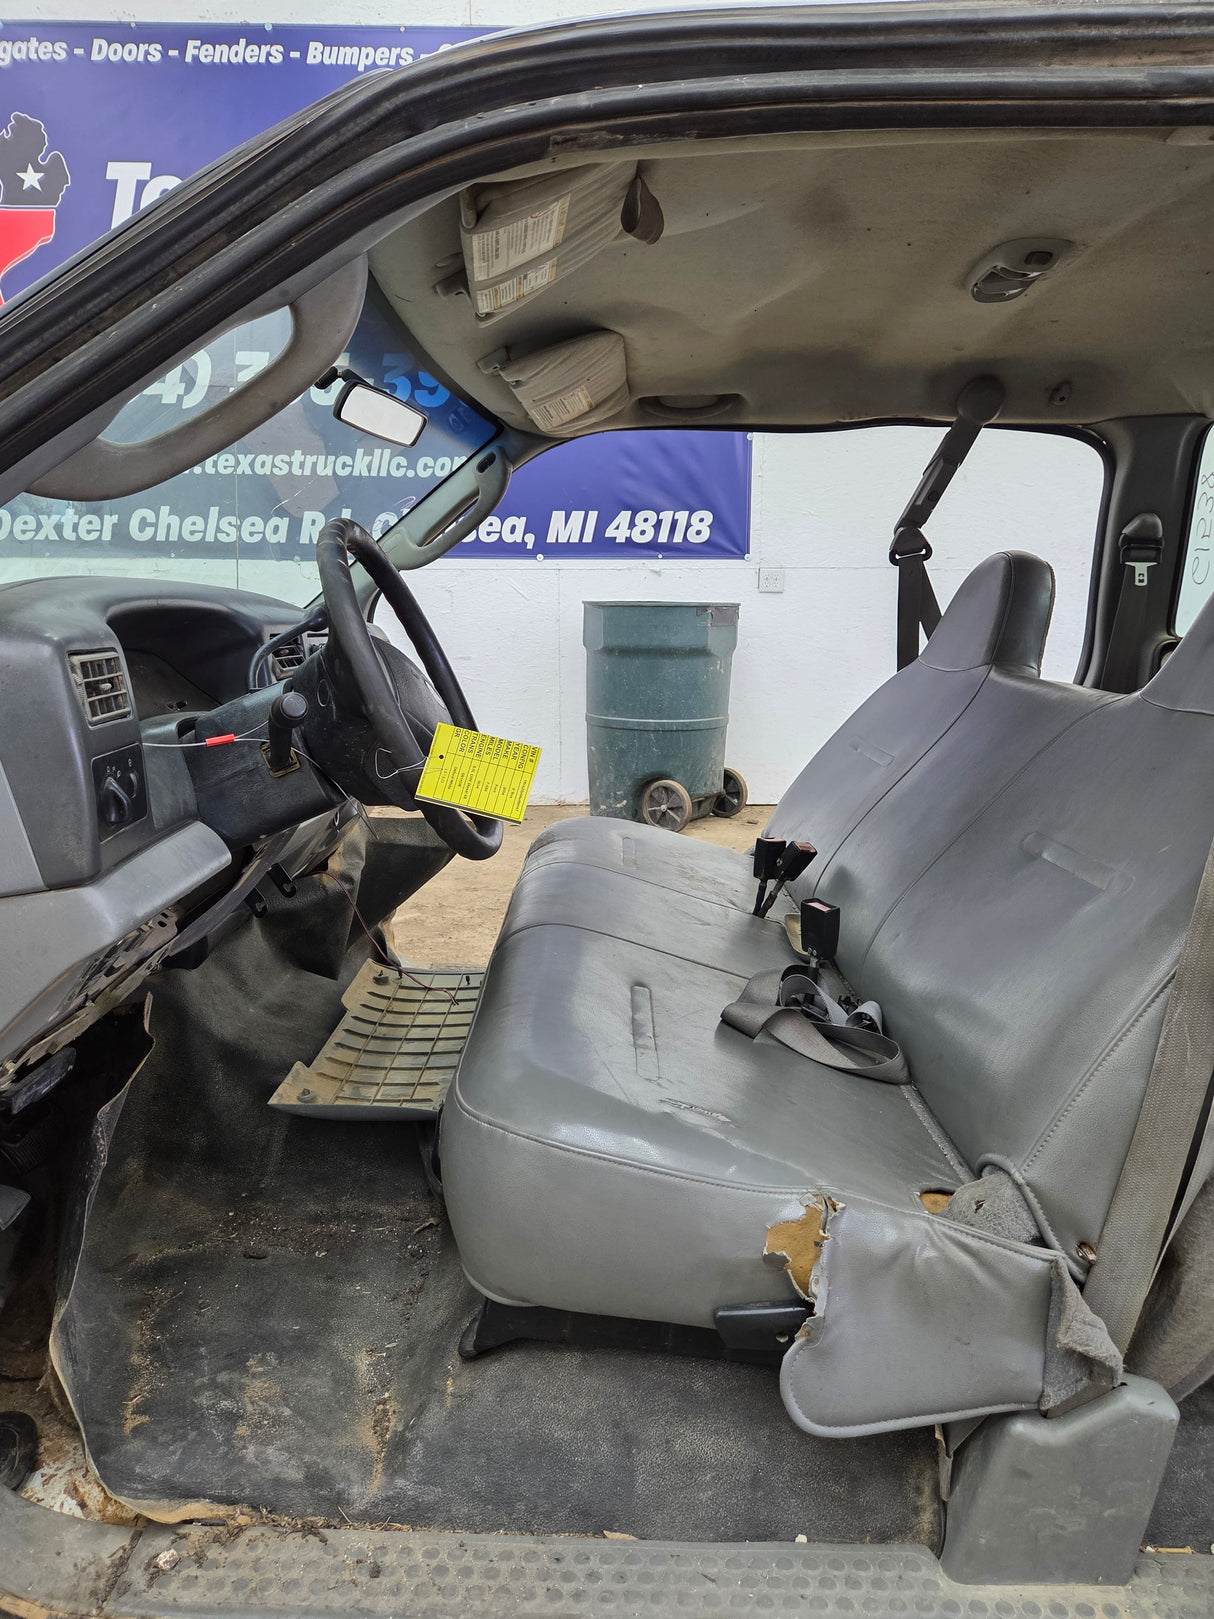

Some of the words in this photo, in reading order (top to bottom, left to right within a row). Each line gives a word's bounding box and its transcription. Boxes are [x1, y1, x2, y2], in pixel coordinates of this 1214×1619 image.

[91, 38, 162, 62] Doors
[185, 38, 284, 63] Fenders
[306, 41, 414, 71] Bumpers
[0, 507, 119, 542] Dexter
[129, 505, 289, 544] Chelsea
[546, 510, 598, 543] MI
[605, 510, 714, 543] 48118
[454, 728, 461, 738] GR
[458, 730, 470, 753] COLOR
[467, 732, 479, 754] TRANS
[475, 734, 487, 758] ENGINE
[485, 736, 495, 756] MILES
[493, 738, 504, 760] MODEL
[501, 740, 513, 759] MAKE
[510, 742, 521, 760] YEAR
[517, 744, 529, 769] CONFIG
[529, 746, 538, 757] VIN
